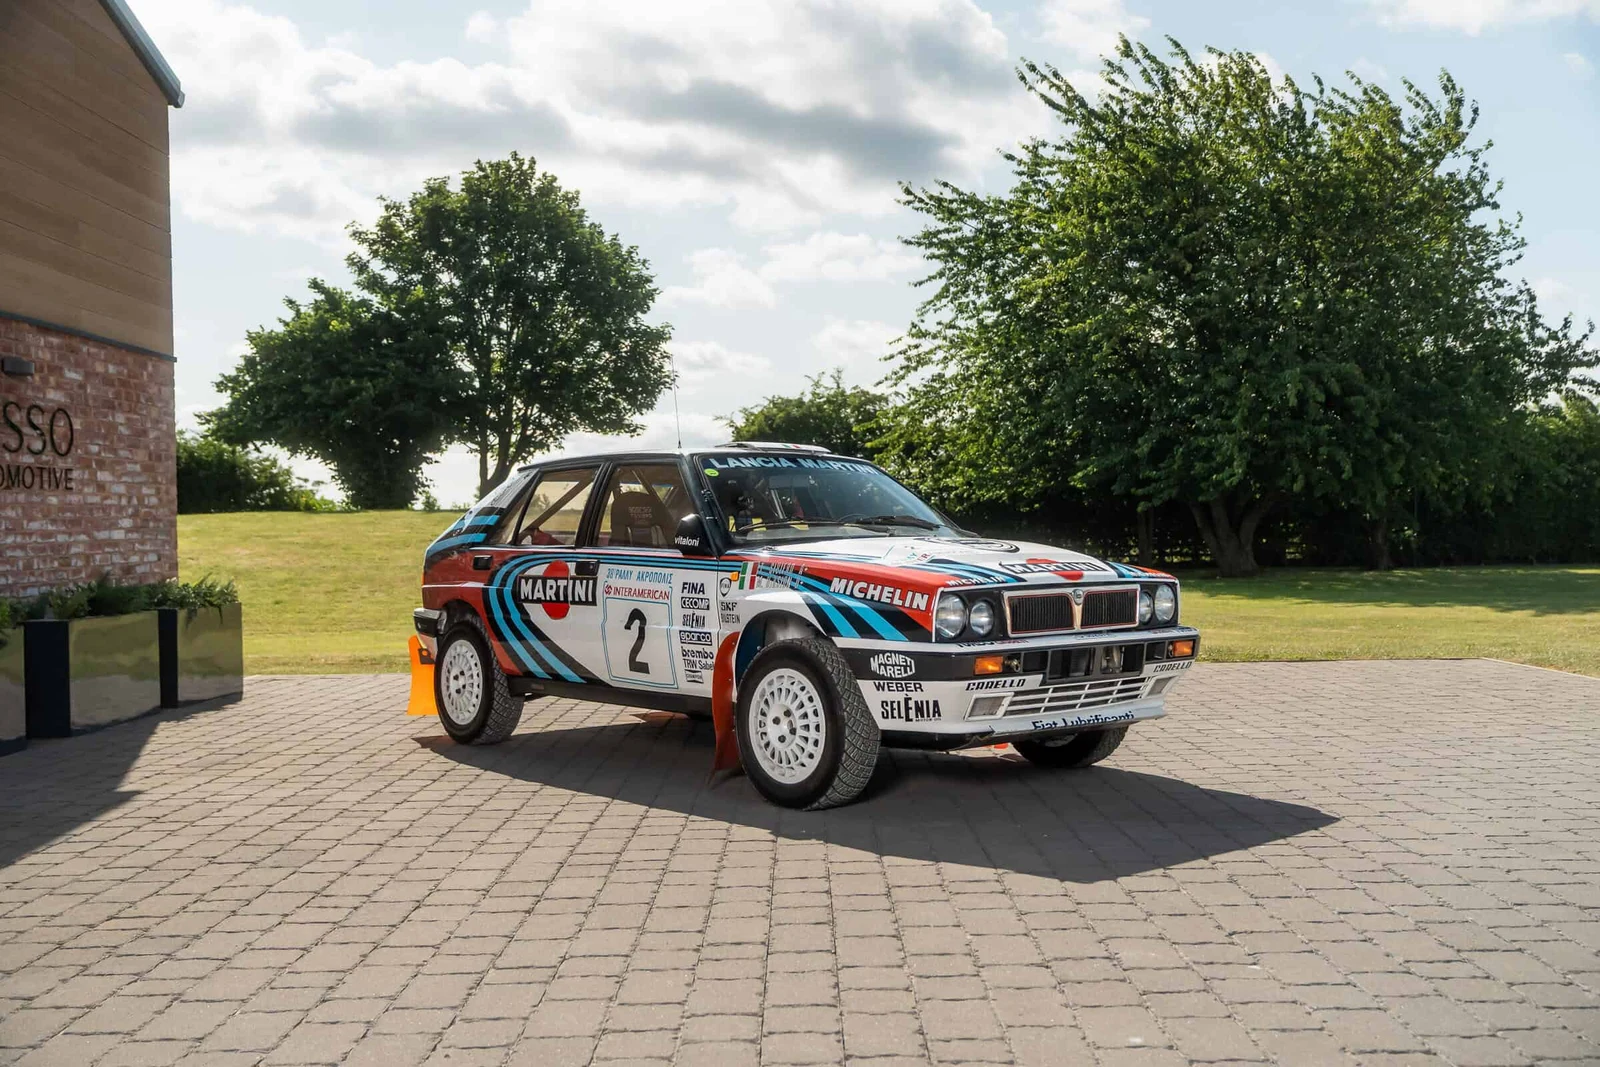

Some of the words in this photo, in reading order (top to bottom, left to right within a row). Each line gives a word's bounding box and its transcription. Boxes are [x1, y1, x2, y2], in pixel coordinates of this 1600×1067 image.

[2, 401, 74, 457] SSO
[709, 457, 794, 469] LANCIA
[797, 458, 880, 475] MARTINI
[674, 536, 700, 547] vitaloni
[945, 575, 1006, 586] MICHELIN
[520, 578, 593, 602] MARTINI
[613, 585, 670, 600] INTERAMERICAN
[681, 581, 705, 595] FINA
[829, 577, 930, 611] MICHELIN
[681, 597, 709, 609] CECOMP
[721, 601, 737, 612] SKF
[624, 608, 651, 675] 2
[680, 631, 711, 642] sparco
[680, 646, 715, 660] brembo
[682, 658, 698, 669] TRW
[870, 652, 915, 670] MAGNETI
[1153, 662, 1192, 673] CARELLO
[870, 660, 915, 679] MARELLI
[873, 681, 924, 693] WEBER
[965, 678, 1026, 691] CARELLO
